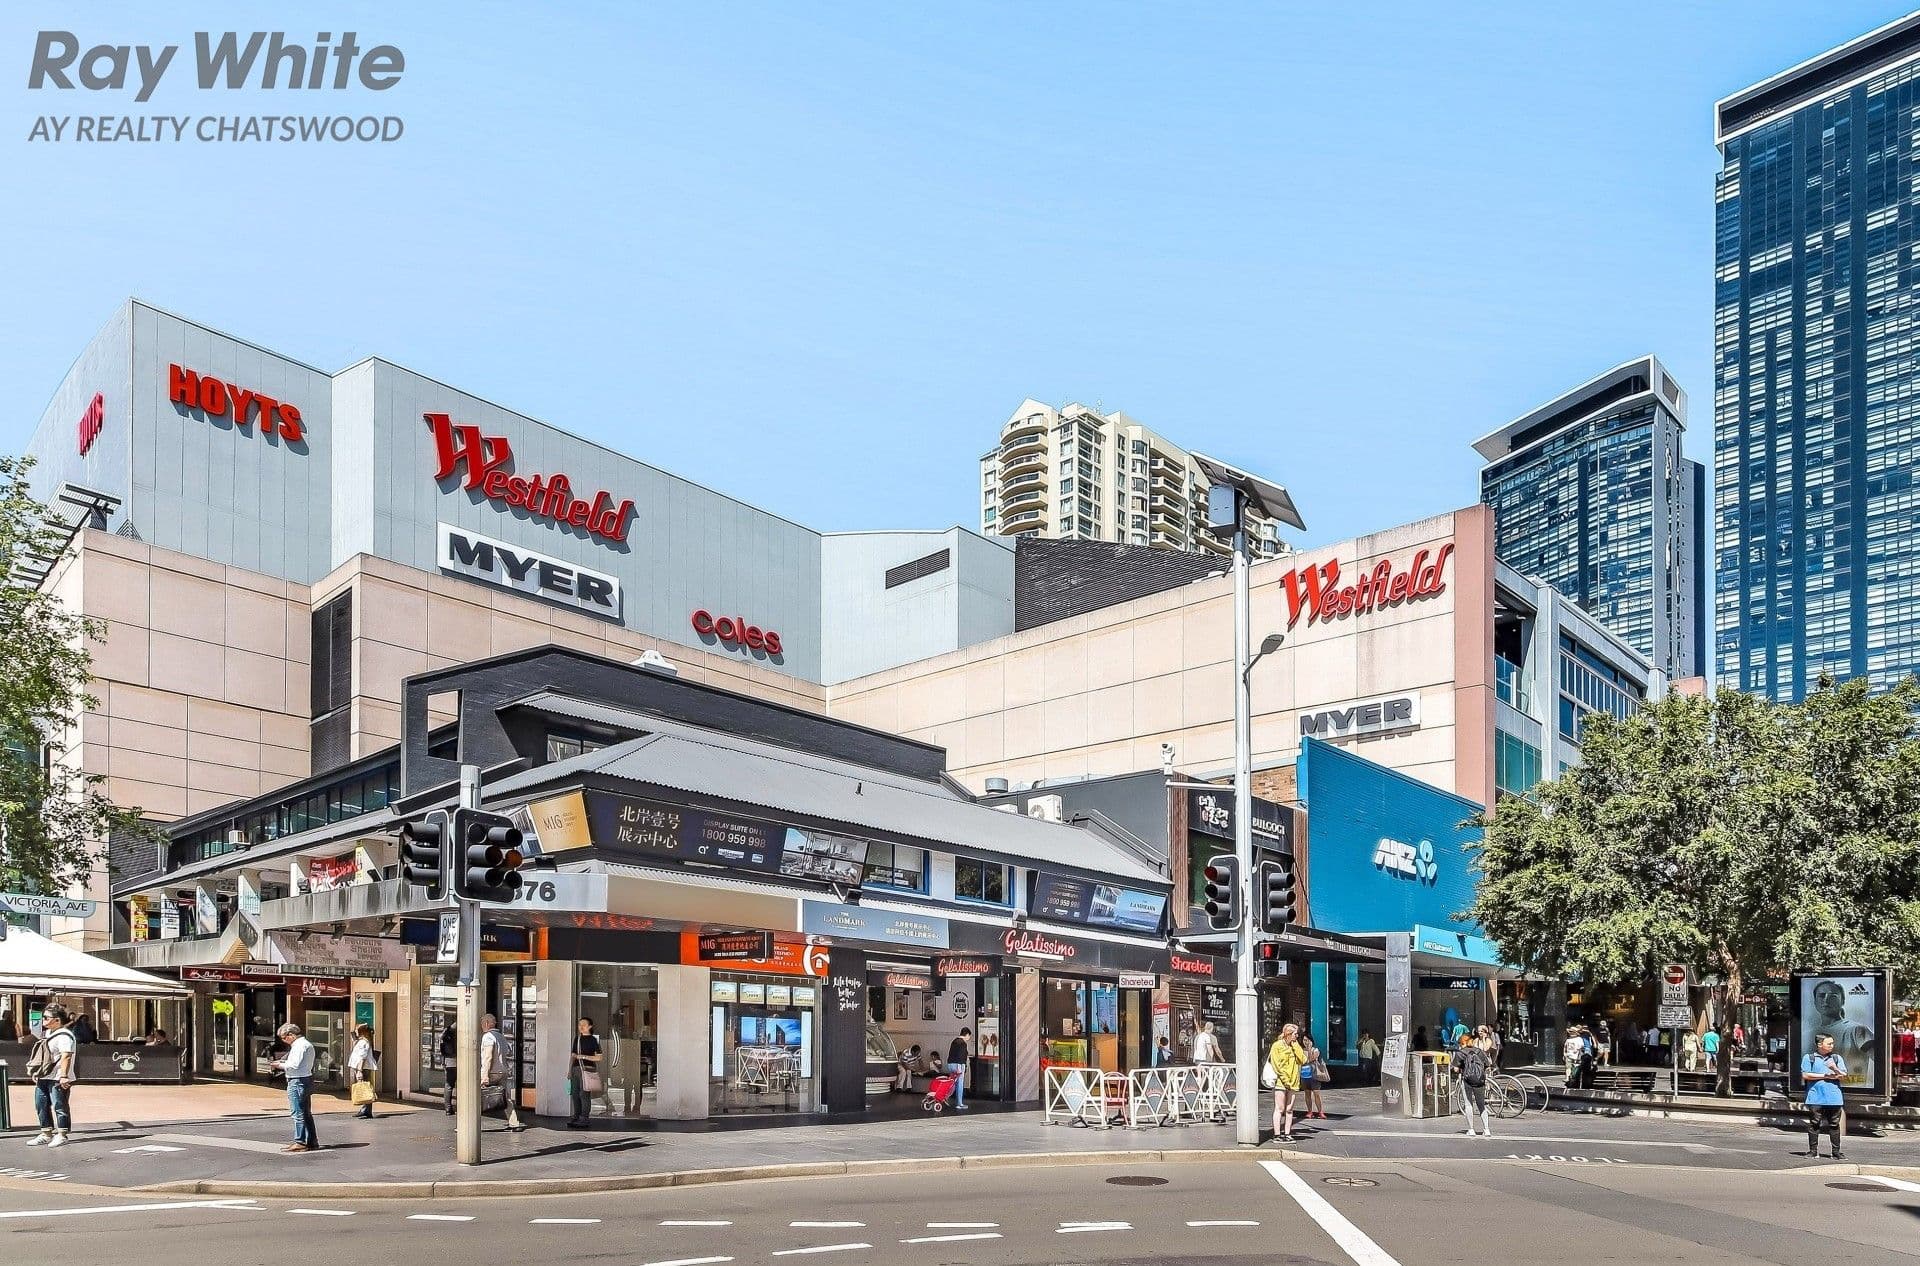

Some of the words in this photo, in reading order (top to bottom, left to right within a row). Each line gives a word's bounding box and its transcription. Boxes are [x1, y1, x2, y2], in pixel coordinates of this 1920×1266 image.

[168, 362, 306, 443] HOYTS
[422, 411, 636, 542] Westfield
[449, 531, 615, 609] MYER
[1279, 542, 1455, 629] Westfield
[691, 608, 783, 656] coles
[1299, 697, 1414, 736] MYER
[703, 819, 730, 830] DISPLAY
[730, 823, 749, 834] SUITE
[1252, 816, 1285, 835] BULGOGI
[617, 825, 679, 849] 展示中心
[702, 828, 726, 842] 1800
[727, 833, 746, 845] 959
[748, 836, 766, 848] 998
[1374, 838, 1417, 875] ANZ
[5, 896, 61, 910] VICTORIA
[66, 901, 88, 912] AVE
[165, 901, 178, 910] TAX
[442, 917, 457, 929] ONE
[823, 914, 866, 927] LANDMARK
[1004, 928, 1076, 957] Gelatissimo
[937, 957, 989, 976] Gelatissimo
[1170, 955, 1213, 975] Sharetea
[886, 973, 929, 987] Gelatissimo
[1120, 977, 1154, 987] Sharetea
[1450, 980, 1469, 988] ANZ
[1525, 1154, 1613, 1164] LOOK
